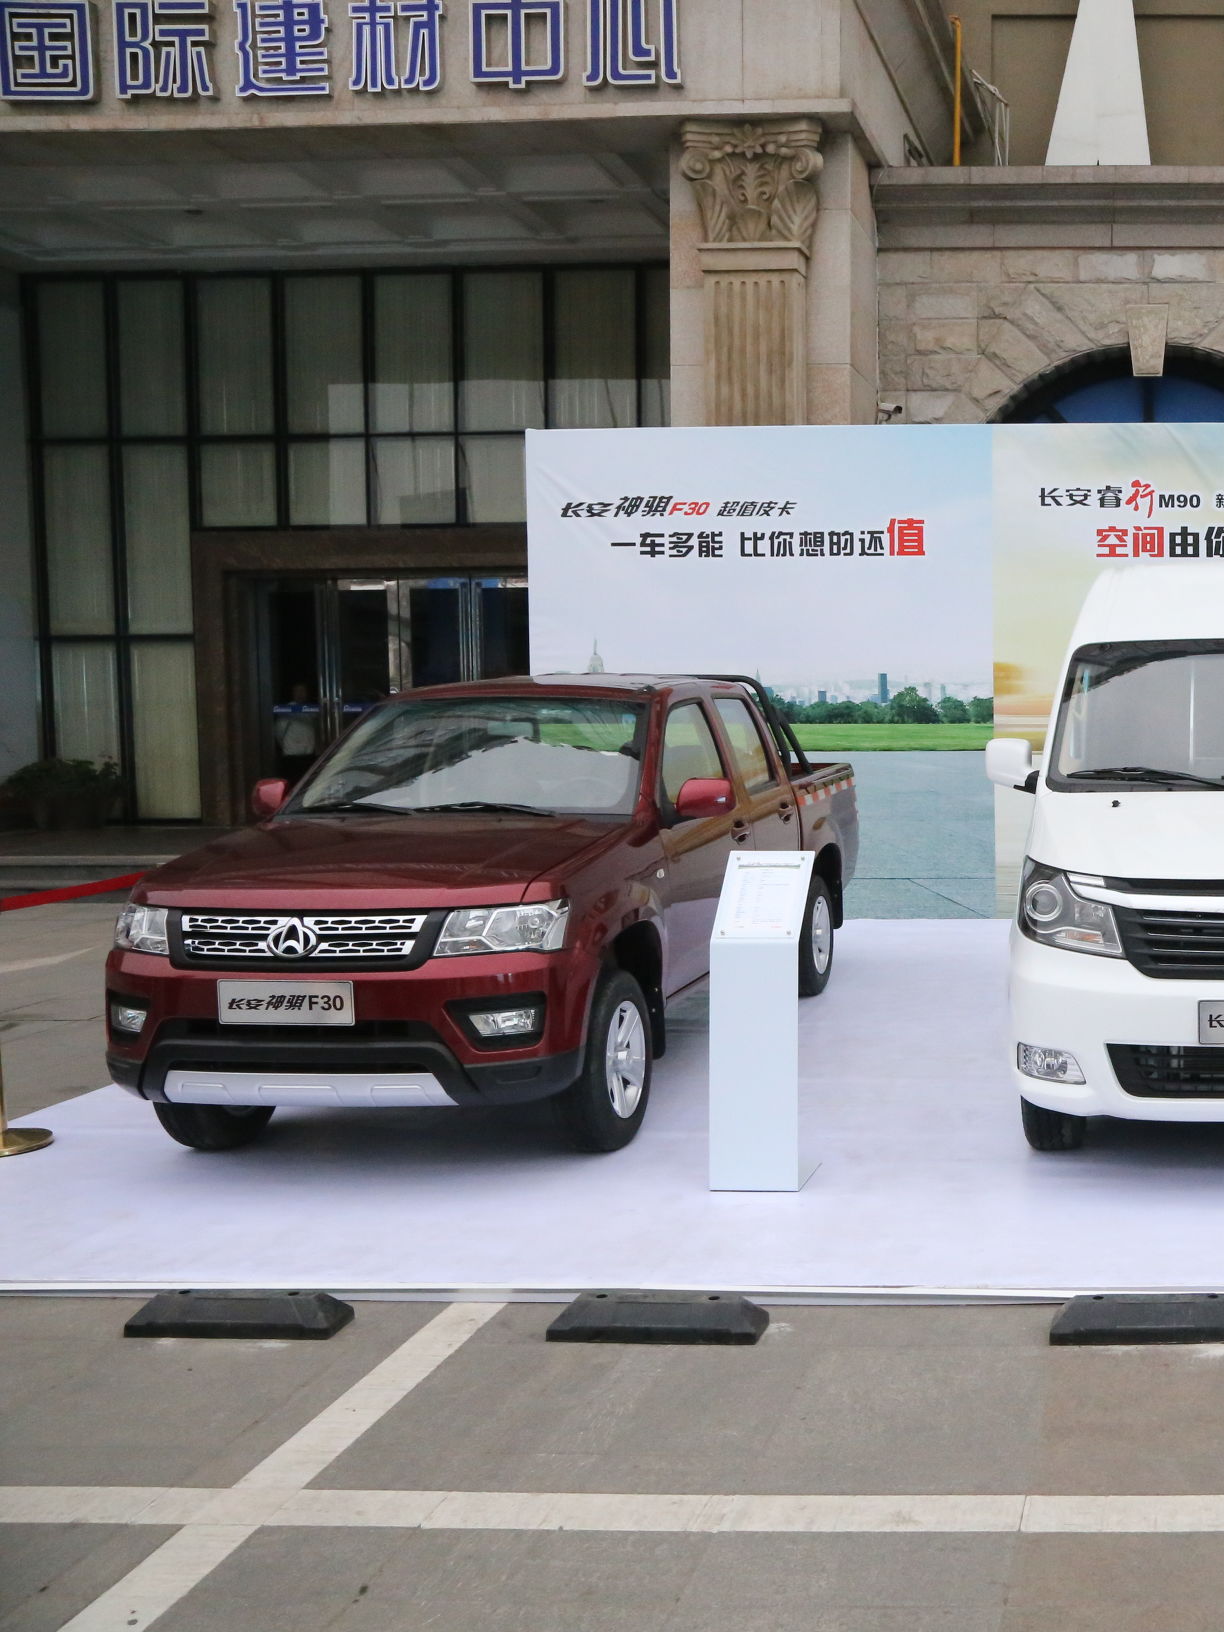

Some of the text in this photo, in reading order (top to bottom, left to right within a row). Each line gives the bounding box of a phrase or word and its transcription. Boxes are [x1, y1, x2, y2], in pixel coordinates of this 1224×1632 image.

[0, 0, 682, 100] 国际建材中心
[717, 501, 798, 518] 超值皮卡
[1038, 479, 1201, 519] 长安睿行M90
[610, 518, 926, 558] 一车多能 比你想的还值
